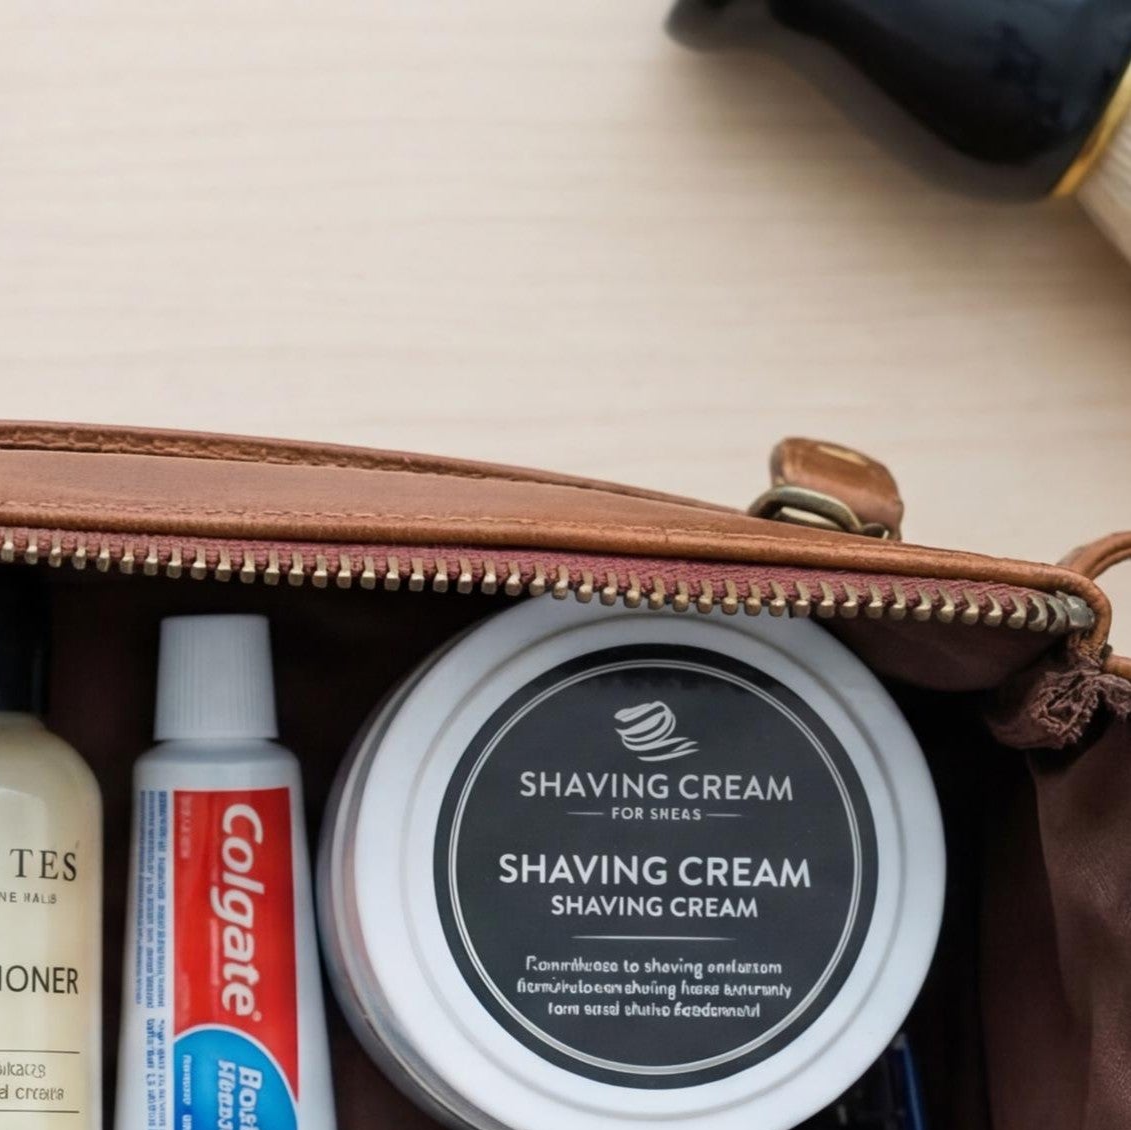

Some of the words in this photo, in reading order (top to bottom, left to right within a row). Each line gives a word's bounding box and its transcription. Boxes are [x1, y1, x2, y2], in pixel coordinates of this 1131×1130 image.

[520, 771, 669, 800] SHAVING
[678, 774, 793, 801] CREAM
[611, 807, 644, 820] FOR
[498, 853, 668, 886] SHAVING
[678, 856, 811, 888] CREAM
[210, 803, 265, 1017] Colgate
[551, 894, 663, 917] SHAVING
[670, 897, 758, 918] CREAM
